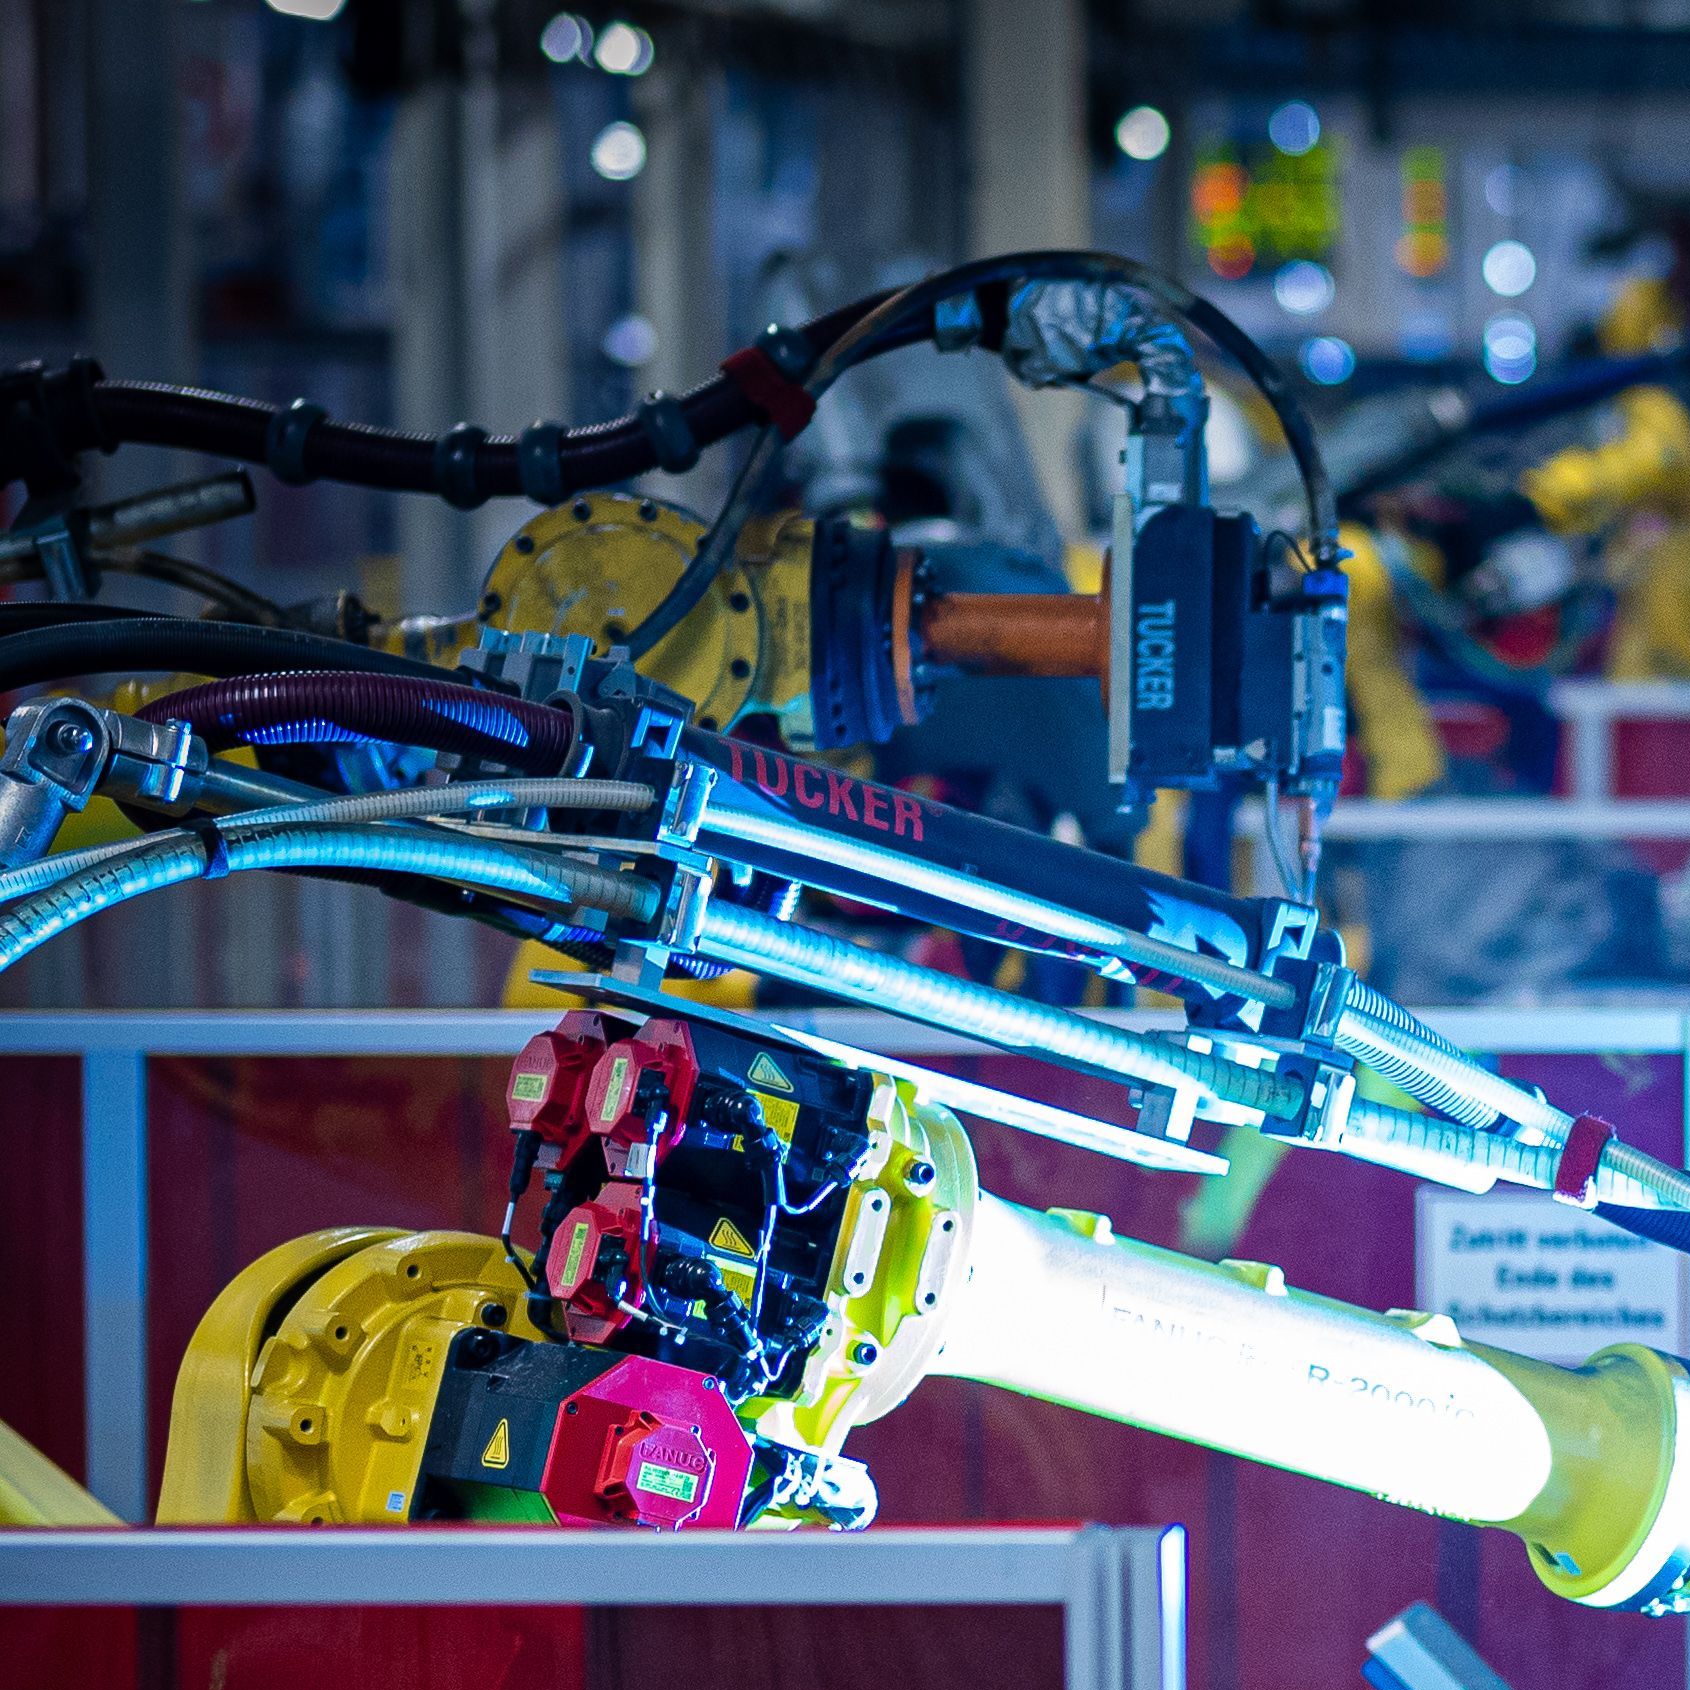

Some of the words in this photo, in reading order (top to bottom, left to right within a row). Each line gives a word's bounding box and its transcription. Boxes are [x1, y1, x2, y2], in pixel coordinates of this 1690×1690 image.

[1136, 598, 1177, 711] TUCKER
[718, 738, 925, 842] TUCKER
[1496, 1264, 1558, 1291] Ende
[1570, 1265, 1615, 1290] des
